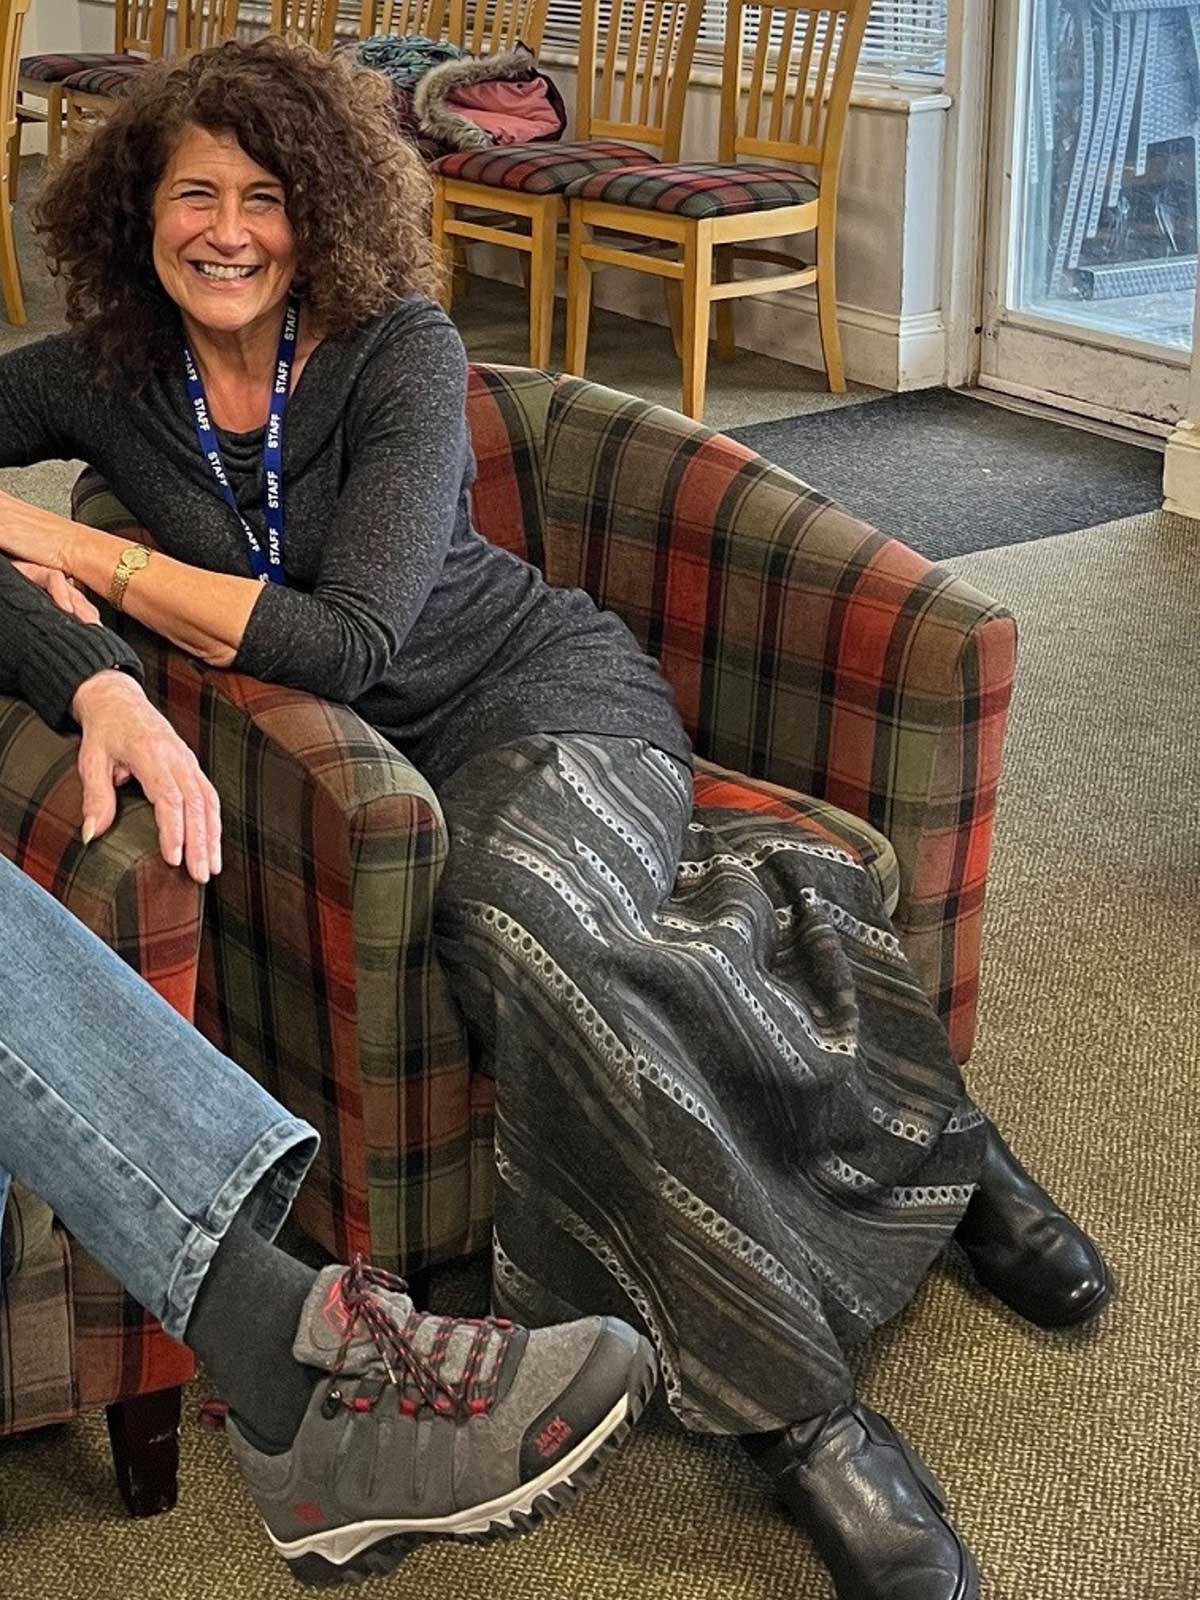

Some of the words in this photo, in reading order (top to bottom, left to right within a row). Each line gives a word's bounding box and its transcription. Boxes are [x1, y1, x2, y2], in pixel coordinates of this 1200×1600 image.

[284, 307, 297, 341] STAFF
[184, 349, 198, 381] TAFF
[275, 360, 289, 393] STAFF
[193, 398, 210, 431] STAFF
[268, 413, 281, 449] STAFF
[207, 451, 229, 487] STAFF
[267, 470, 279, 509] STAFF
[241, 518, 261, 552] TAFF
[269, 527, 280, 565] STAFF
